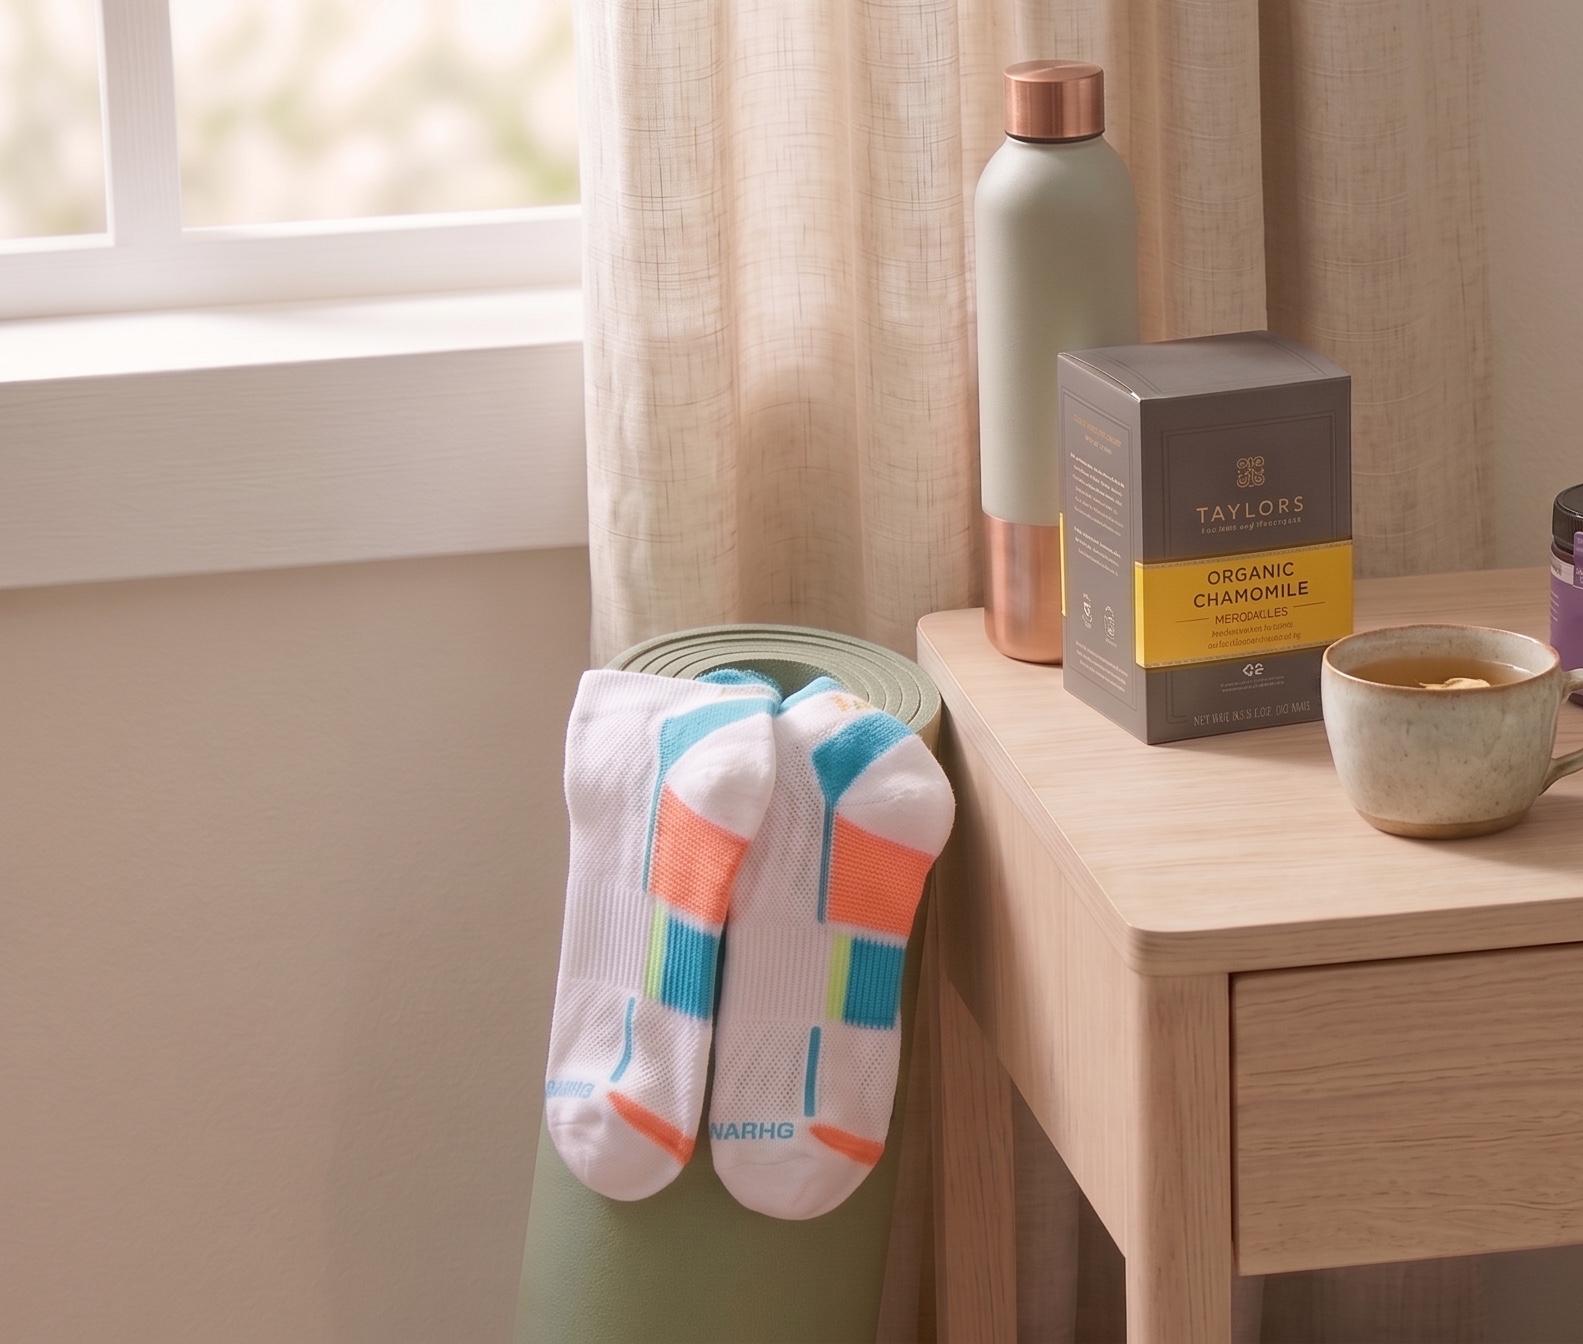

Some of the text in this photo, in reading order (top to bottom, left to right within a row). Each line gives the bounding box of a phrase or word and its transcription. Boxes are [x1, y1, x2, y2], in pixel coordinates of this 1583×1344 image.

[1196, 496, 1304, 523] TAYLORS
[1207, 561, 1294, 585] ORGANIC
[1193, 581, 1309, 608] CHAMOMILE
